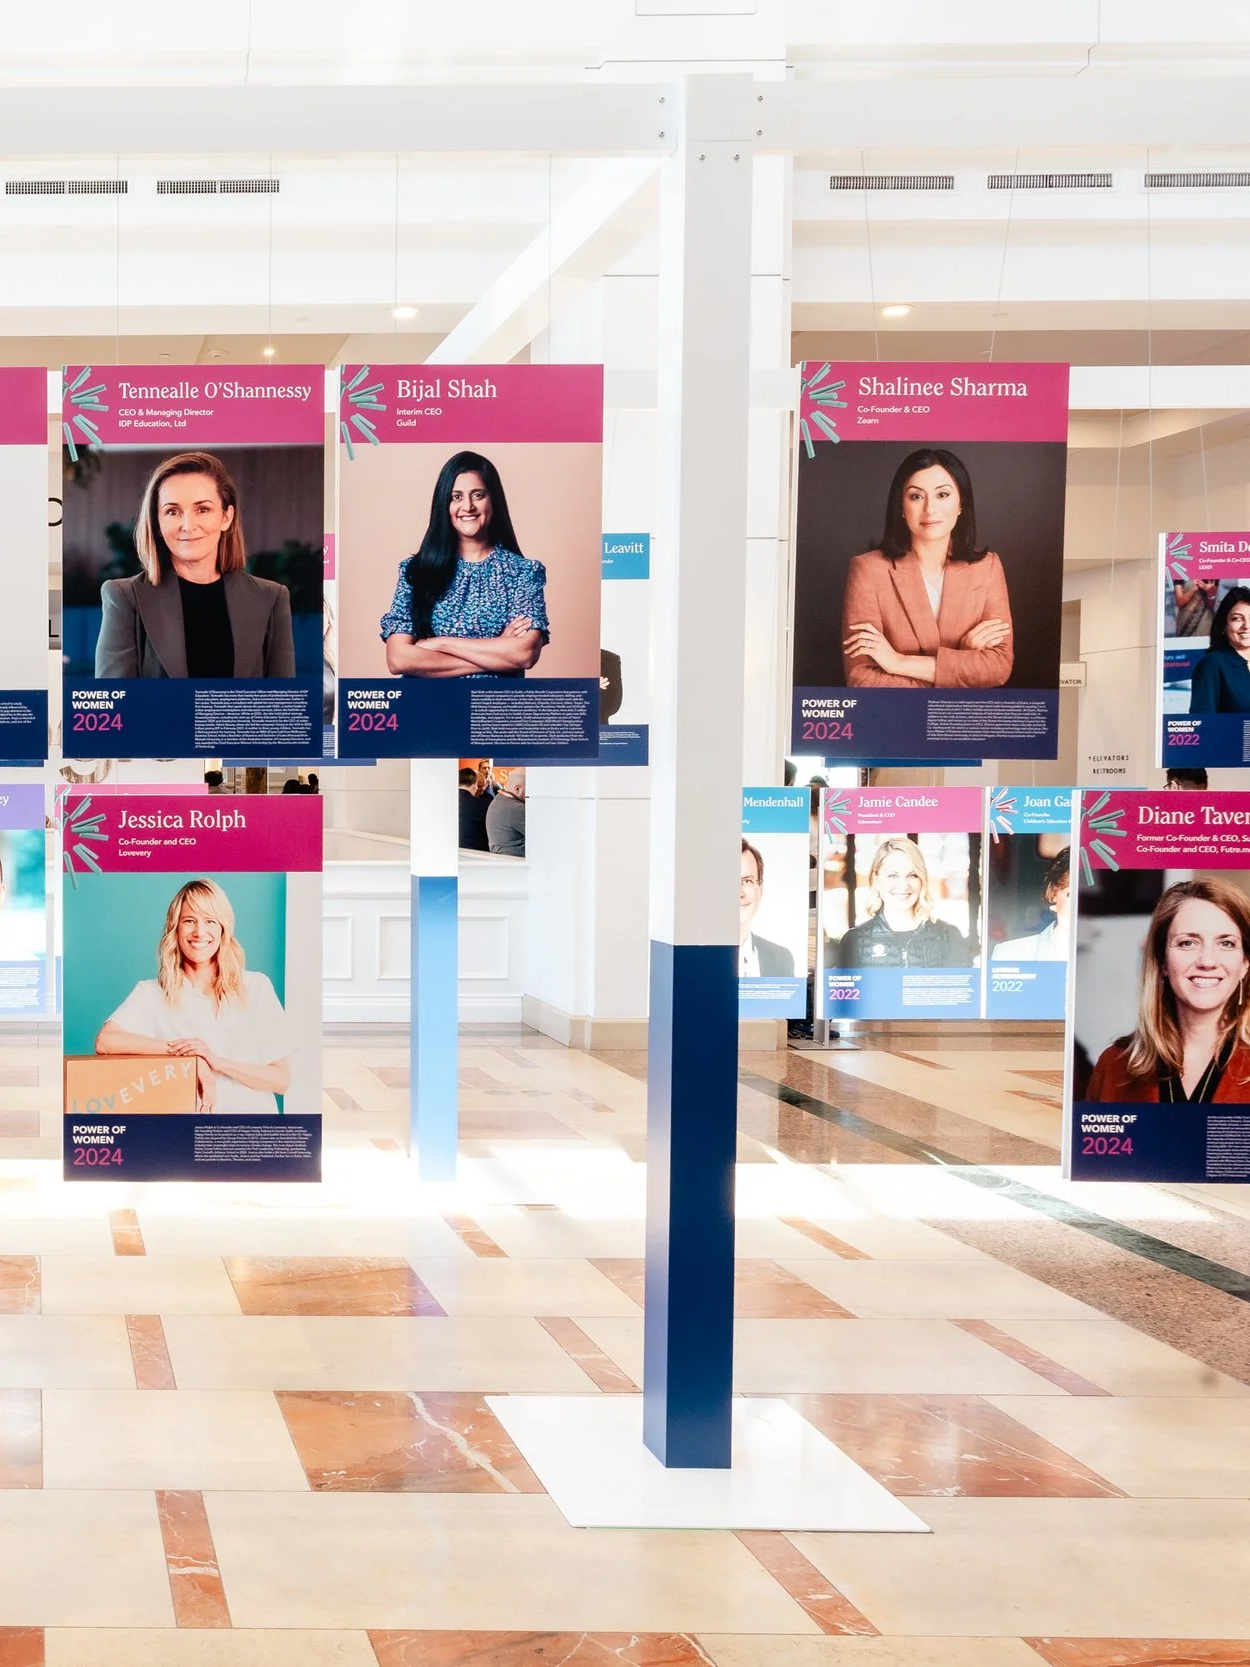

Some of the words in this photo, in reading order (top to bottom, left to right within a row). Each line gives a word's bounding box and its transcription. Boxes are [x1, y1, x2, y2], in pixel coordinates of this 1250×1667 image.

[118, 381, 199, 400] Tennealle
[204, 381, 312, 402] O’Shannessy
[397, 378, 441, 402] Bijal
[447, 378, 498, 399] Shah
[858, 376, 944, 397] Shalinee
[950, 376, 1029, 397] Sharma
[118, 409, 136, 417] CEO
[138, 409, 144, 417] &
[146, 408, 182, 419] Managing
[183, 408, 214, 417] Director
[396, 408, 423, 416] Interim
[424, 408, 442, 416] CEO
[857, 405, 902, 414] Co-Founder
[904, 405, 910, 414] &
[912, 405, 930, 414] CEO
[118, 420, 132, 428] IDP
[133, 419, 173, 429] Education,
[174, 419, 187, 428] Ltd
[396, 419, 417, 427] Guild
[604, 541, 645, 554] Leavitt
[1199, 541, 1235, 553] Smita
[72, 690, 110, 699] POWER
[111, 690, 126, 699] OF
[347, 690, 386, 699] POWER
[387, 690, 402, 699] OF
[72, 700, 114, 709] WOMEN
[347, 700, 390, 709] WOMEN
[802, 699, 840, 708] POWER
[842, 700, 857, 708] OF
[802, 709, 844, 718] WOMEN
[72, 713, 123, 731] 2024
[348, 713, 399, 731] 2024
[802, 722, 854, 740] 2024
[1168, 734, 1200, 745] 2022
[743, 796, 804, 807] Mendenhall
[858, 796, 892, 808] Jamie
[895, 796, 938, 807] Candee
[1023, 795, 1051, 807] Joan
[118, 809, 184, 829] Jessica
[189, 810, 247, 832] Rolph
[1138, 806, 1195, 825] Diane
[118, 837, 162, 846] Co-Founder
[164, 837, 177, 846] and
[179, 837, 196, 846] CEO
[1136, 834, 1164, 842] Former
[1165, 834, 1211, 842] Co-Founder
[1212, 834, 1219, 842] &
[1220, 834, 1240, 843] CEO,
[118, 849, 152, 858] Lovevery
[1136, 845, 1181, 853] Co-Founder
[1198, 846, 1219, 854] CEO,
[992, 980, 1023, 992] 2022
[829, 988, 860, 1000] 2022
[72, 1061, 192, 1114] LOVEVERY
[1082, 1114, 1119, 1123] POWER
[1121, 1114, 1137, 1123] OF
[73, 1126, 110, 1134] POWER
[111, 1126, 126, 1134] OF
[1081, 1125, 1124, 1133] WOMEN
[72, 1136, 114, 1144] WOMEN
[1082, 1137, 1134, 1155] 2024
[73, 1148, 123, 1165] 2024
